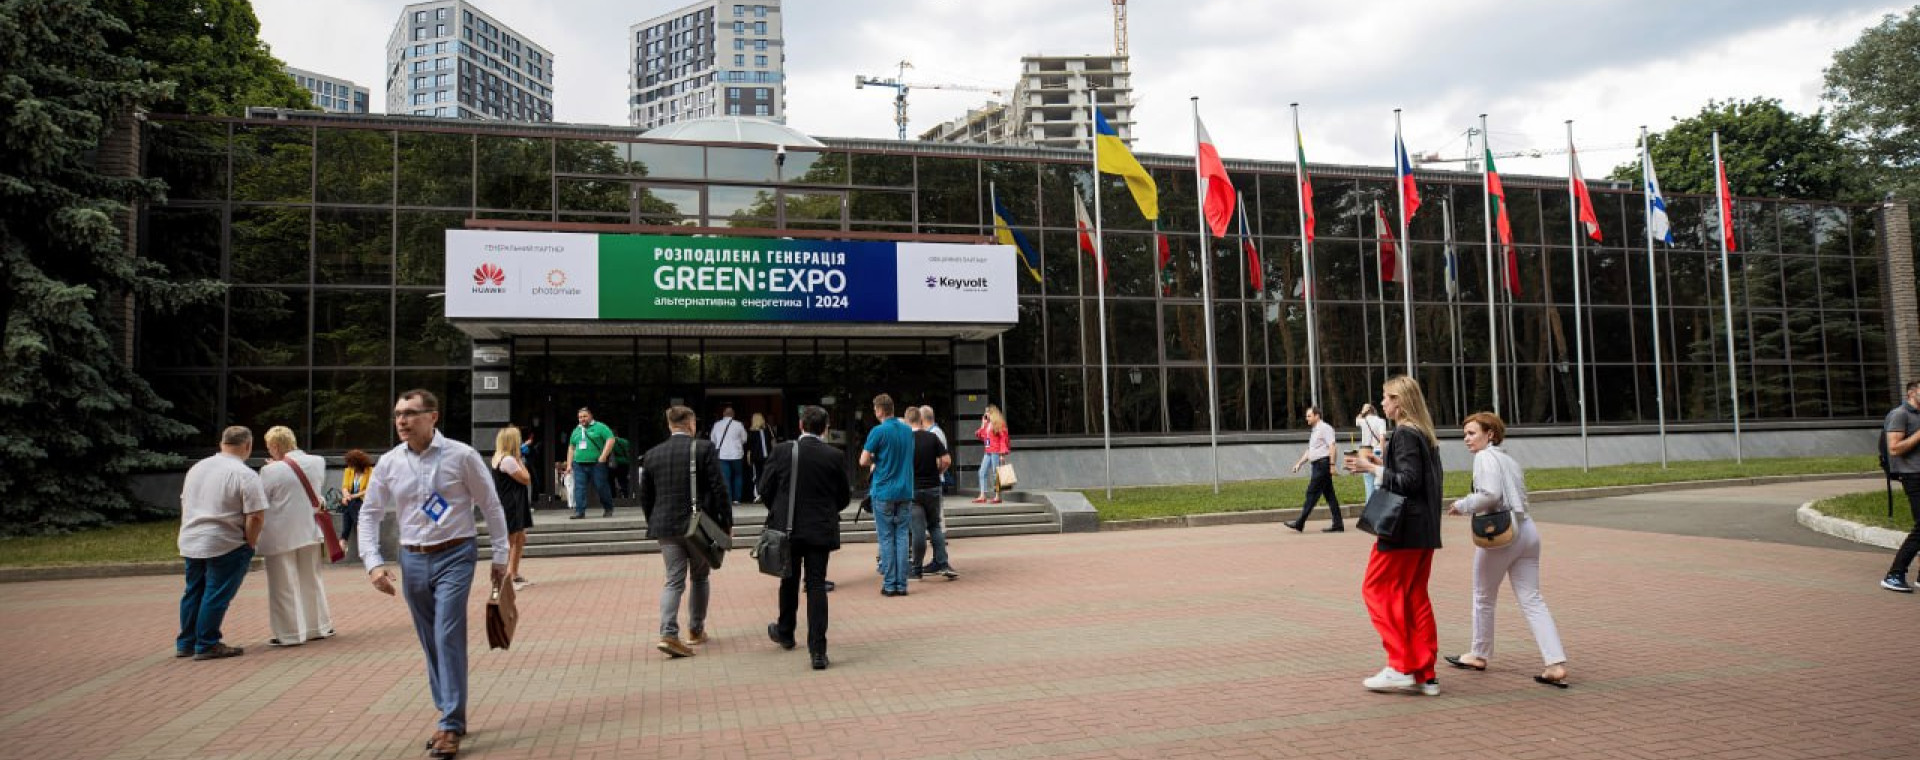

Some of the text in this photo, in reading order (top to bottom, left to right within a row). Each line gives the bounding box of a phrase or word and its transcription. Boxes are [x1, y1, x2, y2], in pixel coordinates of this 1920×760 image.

[654, 248, 846, 266] РОЗПОДІЛЕНА ГЕНЕРАЦІЯ
[939, 276, 988, 289] Keyvolt
[472, 286, 506, 294] HUAWEI
[532, 285, 581, 296] photomate
[654, 296, 849, 310] альтернативна енергетика 2024
